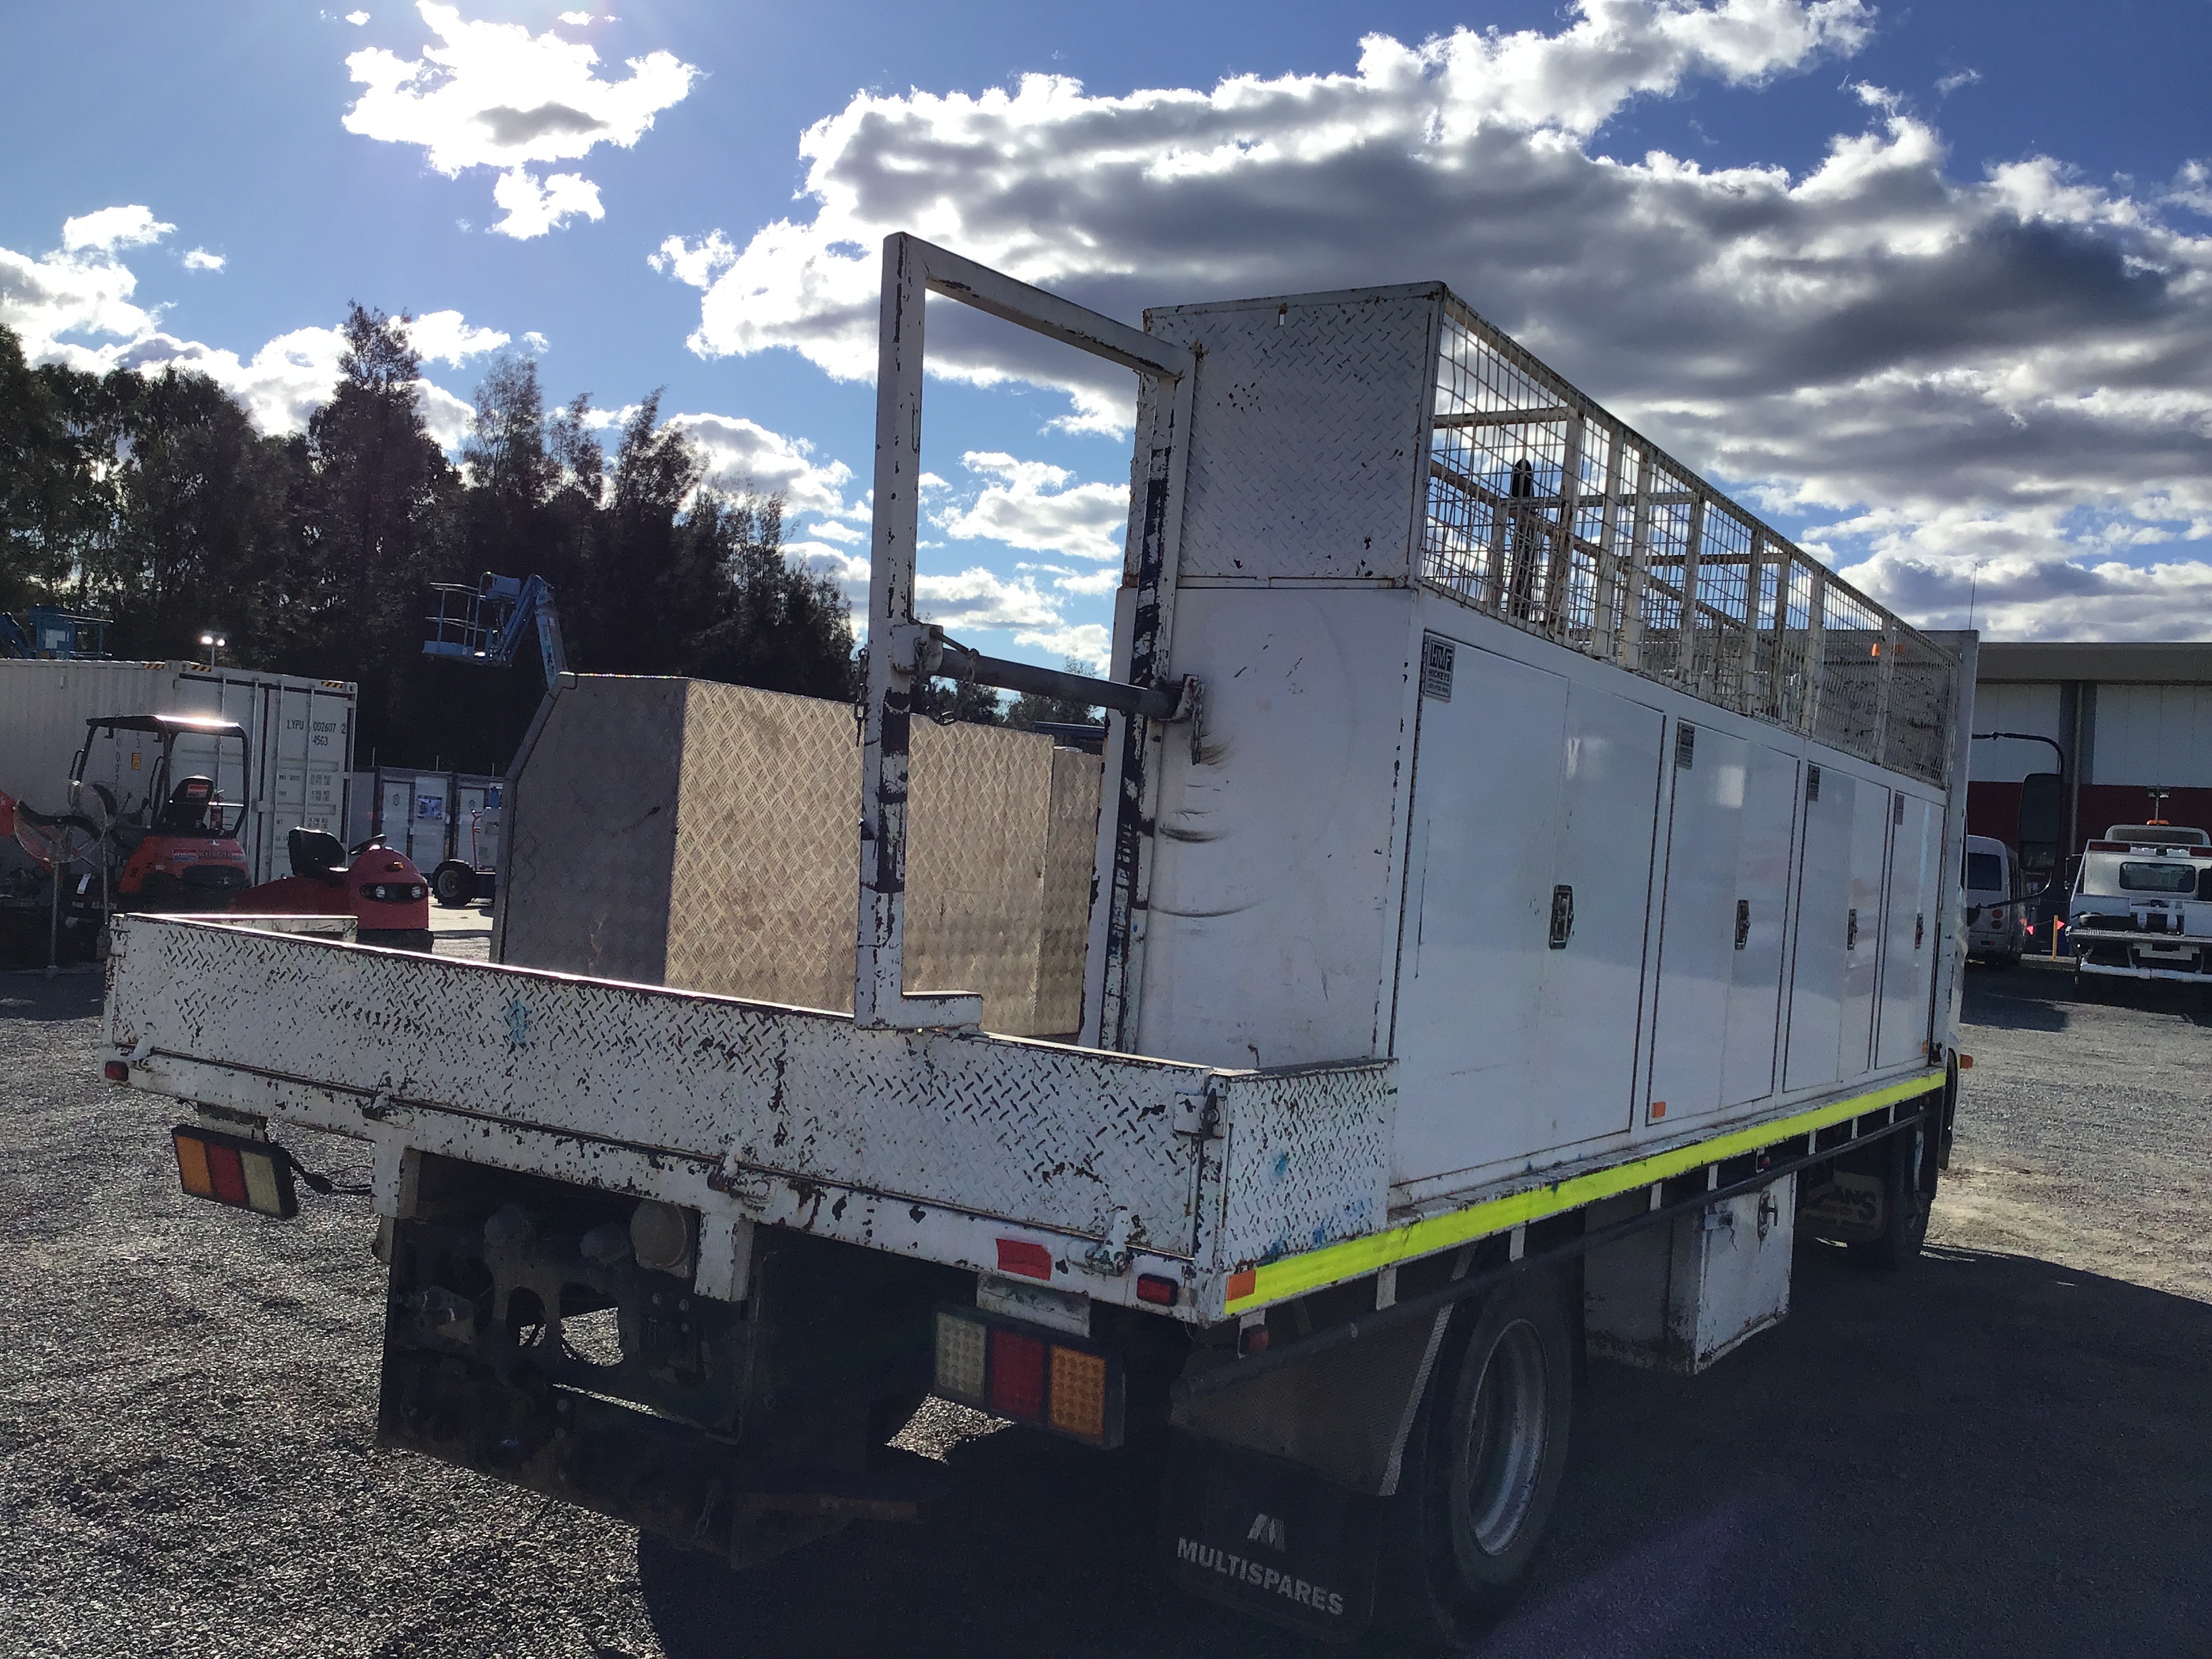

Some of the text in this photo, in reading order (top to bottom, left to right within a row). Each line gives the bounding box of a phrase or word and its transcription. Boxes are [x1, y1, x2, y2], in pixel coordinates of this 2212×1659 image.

[1431, 644, 1453, 671] HMF
[287, 719, 346, 734] LYPU 002607 2
[312, 735, 329, 745] 45G3
[1177, 1537, 1344, 1616] MULTISPARES
